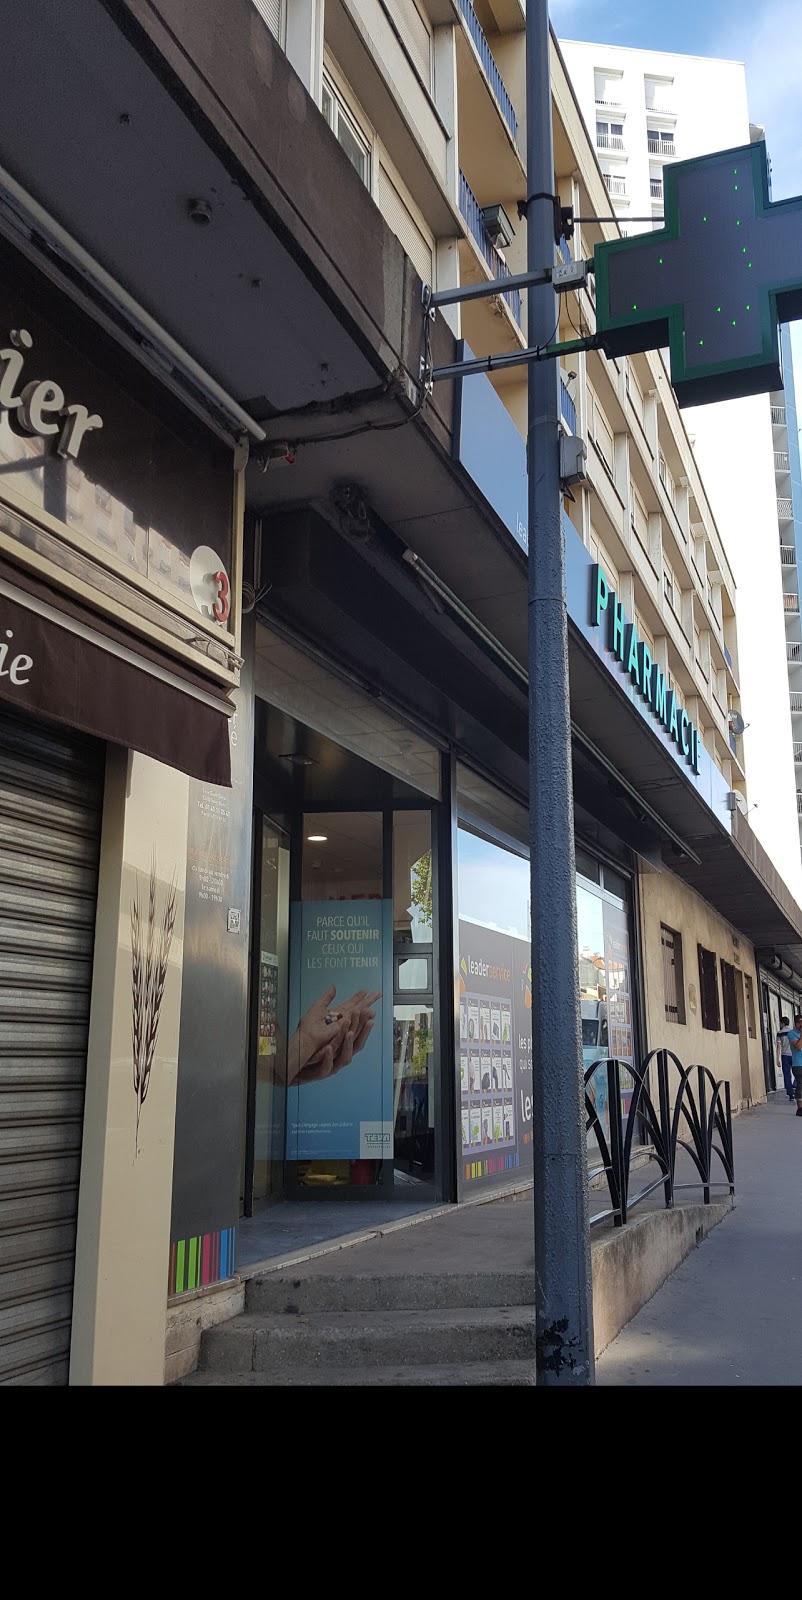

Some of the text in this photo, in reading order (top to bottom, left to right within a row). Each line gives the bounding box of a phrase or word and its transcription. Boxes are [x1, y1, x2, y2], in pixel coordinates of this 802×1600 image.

[212, 570, 229, 622] 3
[588, 563, 702, 776] PHARMACIE
[316, 916, 370, 927] PARCE QU'IL
[307, 929, 380, 941] FAUT SOUTENIR
[322, 943, 364, 954] CEUX QUI
[307, 956, 379, 968] LES FONT TENIR
[468, 954, 510, 982] leaderservice
[364, 1132, 390, 1142] TEVA
